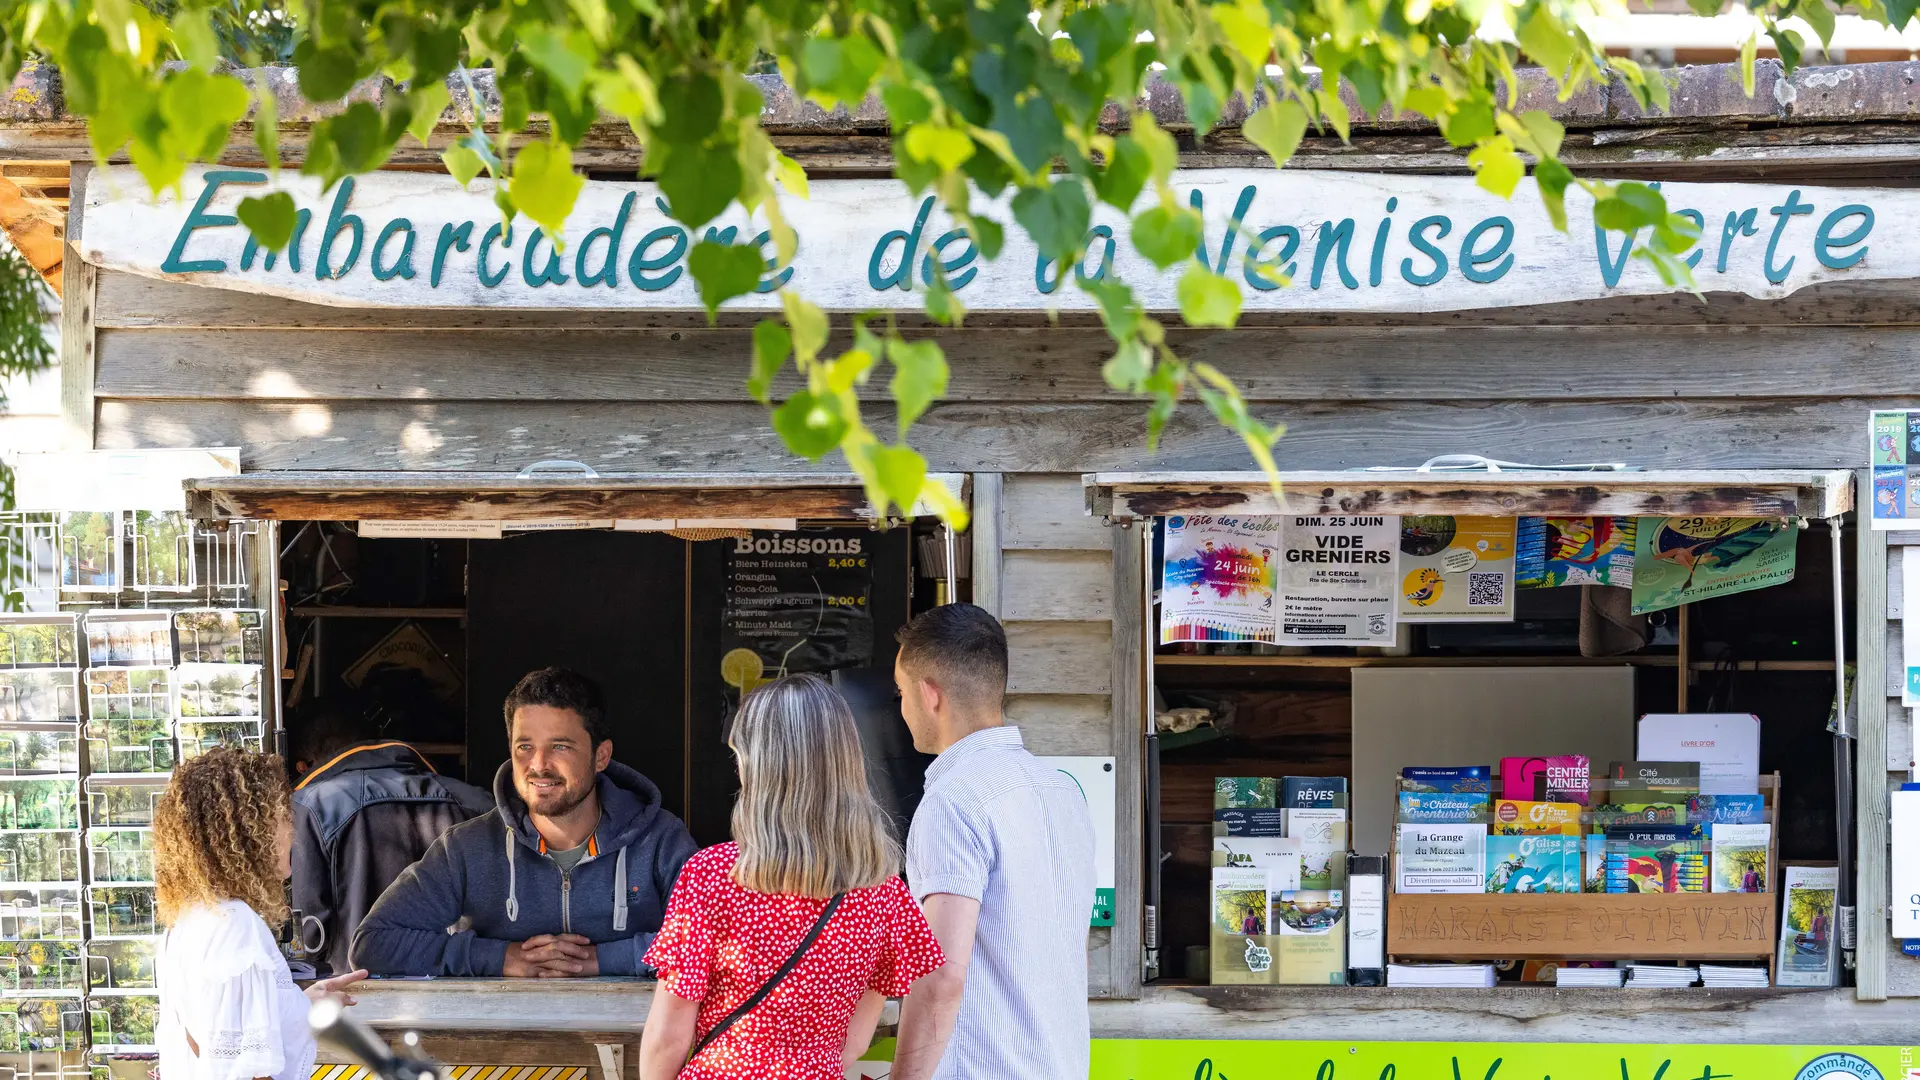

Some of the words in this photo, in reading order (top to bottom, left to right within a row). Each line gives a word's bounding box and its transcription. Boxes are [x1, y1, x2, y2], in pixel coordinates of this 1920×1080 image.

[868, 195, 978, 291] de
[1190, 185, 1515, 290] Venise
[1877, 425, 1902, 433] 2019
[1876, 479, 1903, 487] 2014
[1217, 515, 1239, 528] des
[1242, 517, 1280, 532] écoles
[1295, 517, 1325, 527] DIM.
[1329, 517, 1346, 527] 25
[1350, 517, 1384, 527] JUIN
[1679, 517, 1704, 530] 29
[1690, 522, 1731, 536] JUILLET
[733, 533, 861, 554] Boissons
[1315, 535, 1364, 549] VIDE
[1285, 549, 1391, 564] GRENIERS
[1756, 554, 1790, 569] SAMEDI
[735, 560, 759, 568] Bière
[761, 560, 808, 568] Heineken
[828, 558, 855, 569] 2,40
[858, 558, 867, 567] €
[1214, 560, 1231, 571] 24
[1232, 561, 1260, 576] juin
[735, 573, 776, 582] Orangina
[1735, 567, 1772, 581] GRATUITE
[1683, 567, 1795, 597] ST-HILAIRE-LA-PALUD
[735, 585, 778, 593] Coca-Cola
[735, 597, 782, 607] Schwepp's
[783, 598, 814, 607] agrum
[828, 596, 855, 607] 2,00
[857, 597, 866, 606] €
[1284, 595, 1330, 603] Restauration,
[735, 609, 768, 617] Perrier
[735, 621, 768, 629] Minute
[769, 621, 792, 629] Maid
[1546, 767, 1589, 778] CENTRE
[1639, 768, 1658, 777] Cité
[1546, 778, 1589, 789] MINIER
[1645, 776, 1680, 785] oiseaux
[1297, 787, 1335, 801] RÊVES
[1429, 798, 1469, 809] Château
[1547, 806, 1567, 816] Fun
[1711, 803, 1754, 823] Nieul
[1417, 833, 1428, 842] La
[1430, 833, 1464, 843] Grange
[1653, 833, 1676, 841] marais
[1536, 838, 1561, 848] Gliss
[1415, 846, 1427, 855] du
[1429, 846, 1465, 855] Mazeau
[1226, 853, 1253, 863] PAPA
[1399, 906, 1548, 942] MARAIS
[1564, 906, 1768, 942] POITEVIN
